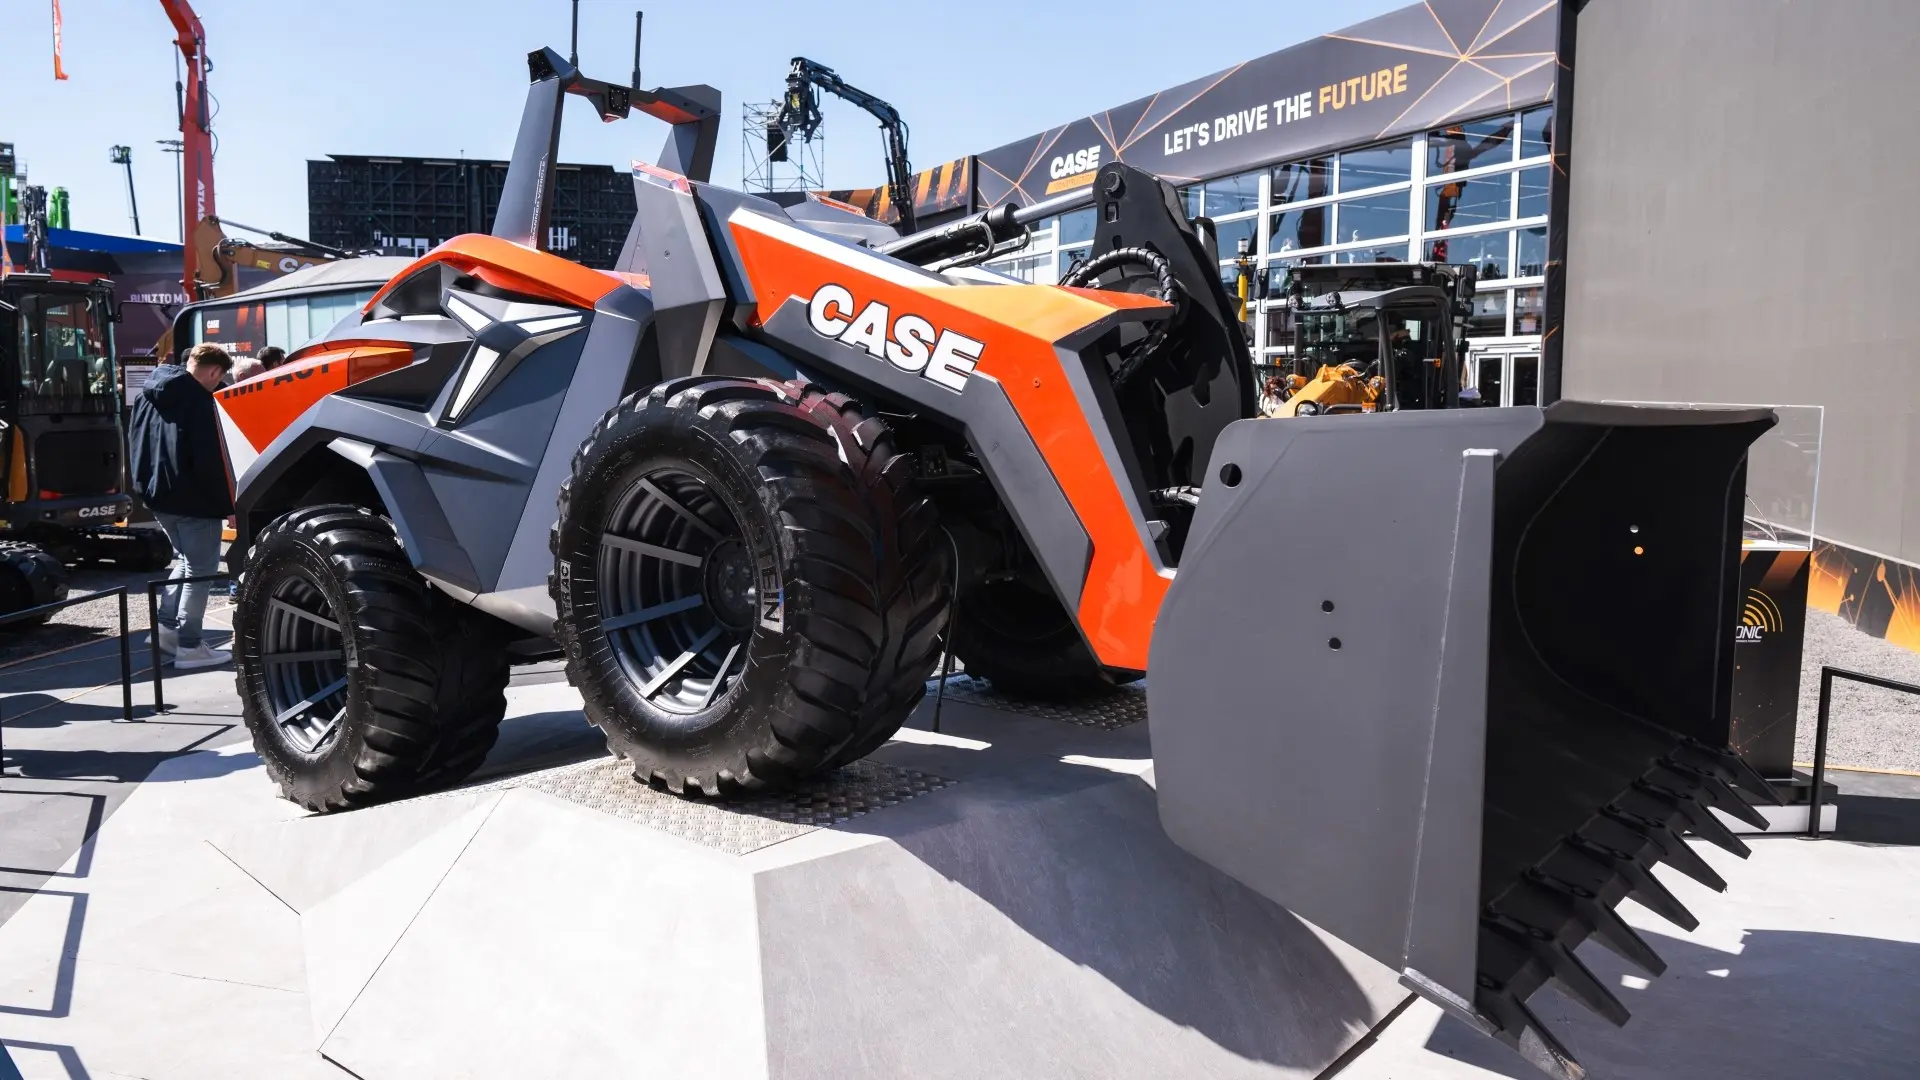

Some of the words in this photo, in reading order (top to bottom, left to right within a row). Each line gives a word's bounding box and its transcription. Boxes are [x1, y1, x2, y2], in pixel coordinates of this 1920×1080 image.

[1164, 123, 1209, 156] LET'S
[1214, 104, 1268, 143] DRIVE
[1273, 91, 1312, 126] THE
[1319, 63, 1408, 114] FUTURE
[1050, 145, 1101, 180] CASE
[158, 293, 172, 304] TO
[810, 283, 985, 392] CASE
[78, 504, 116, 518] CASE
[560, 564, 573, 614] TRAC
